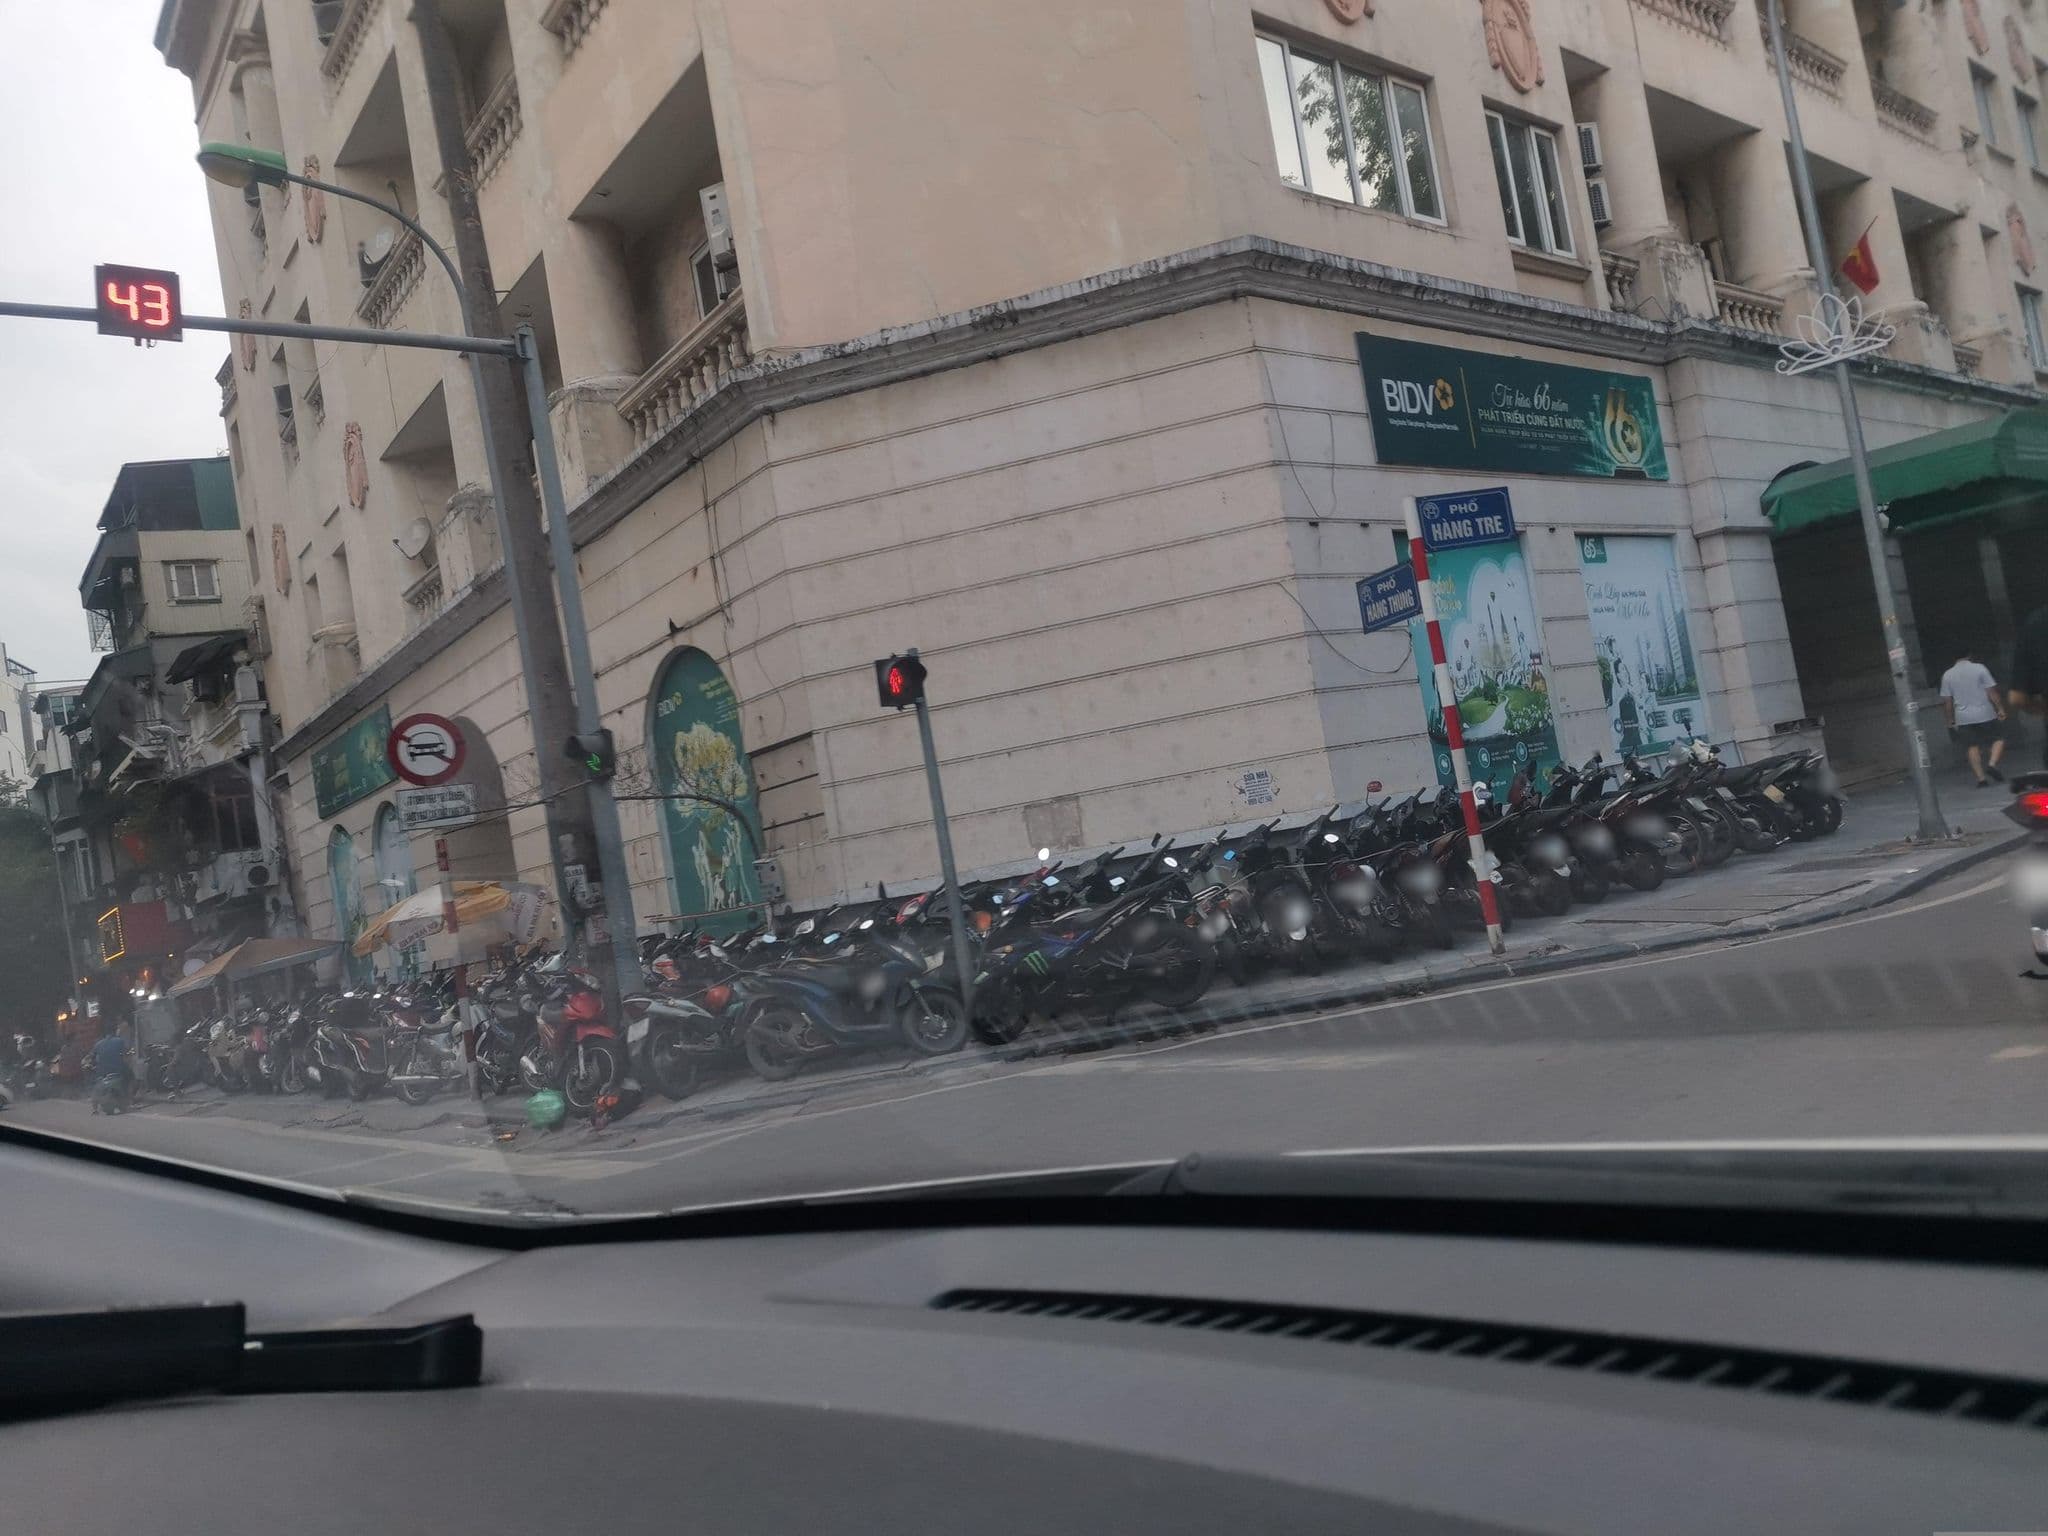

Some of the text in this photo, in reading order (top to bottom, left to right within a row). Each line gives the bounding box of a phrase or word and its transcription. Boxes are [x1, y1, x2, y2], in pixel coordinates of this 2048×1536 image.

[107, 281, 170, 326] 43
[1382, 378, 1435, 415] BIDV
[1448, 497, 1479, 514] PHỐ
[1431, 515, 1504, 541] HÀNG TRE
[1377, 575, 1396, 593] PHỐ
[1388, 589, 1415, 614] THÙNG
